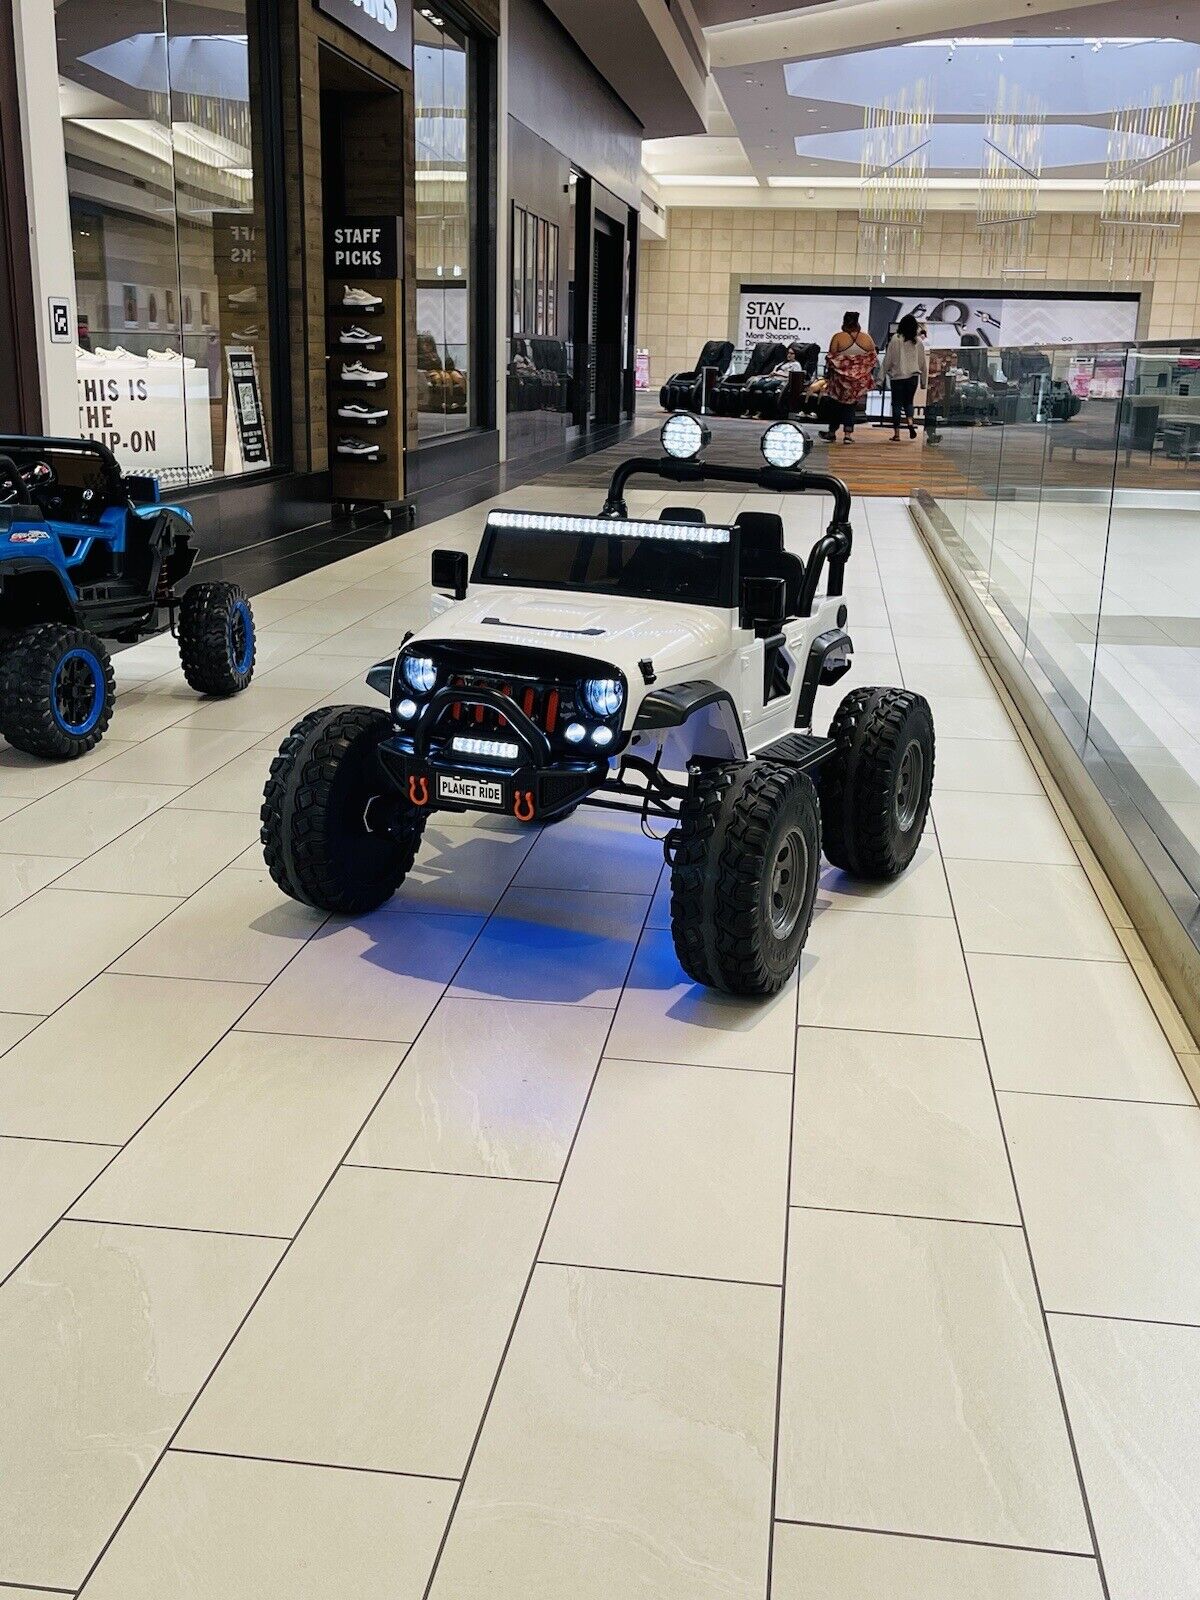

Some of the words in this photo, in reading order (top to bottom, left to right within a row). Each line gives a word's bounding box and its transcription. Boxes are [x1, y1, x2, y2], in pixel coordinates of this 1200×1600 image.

[334, 228, 382, 244] STAFF
[335, 250, 382, 266] PICKS
[746, 301, 785, 316] STAY
[746, 316, 811, 331] TUNED...
[77, 379, 119, 401] HIS
[128, 379, 148, 401] IS
[442, 781, 476, 796] PLANET
[479, 786, 500, 800] RIDE
